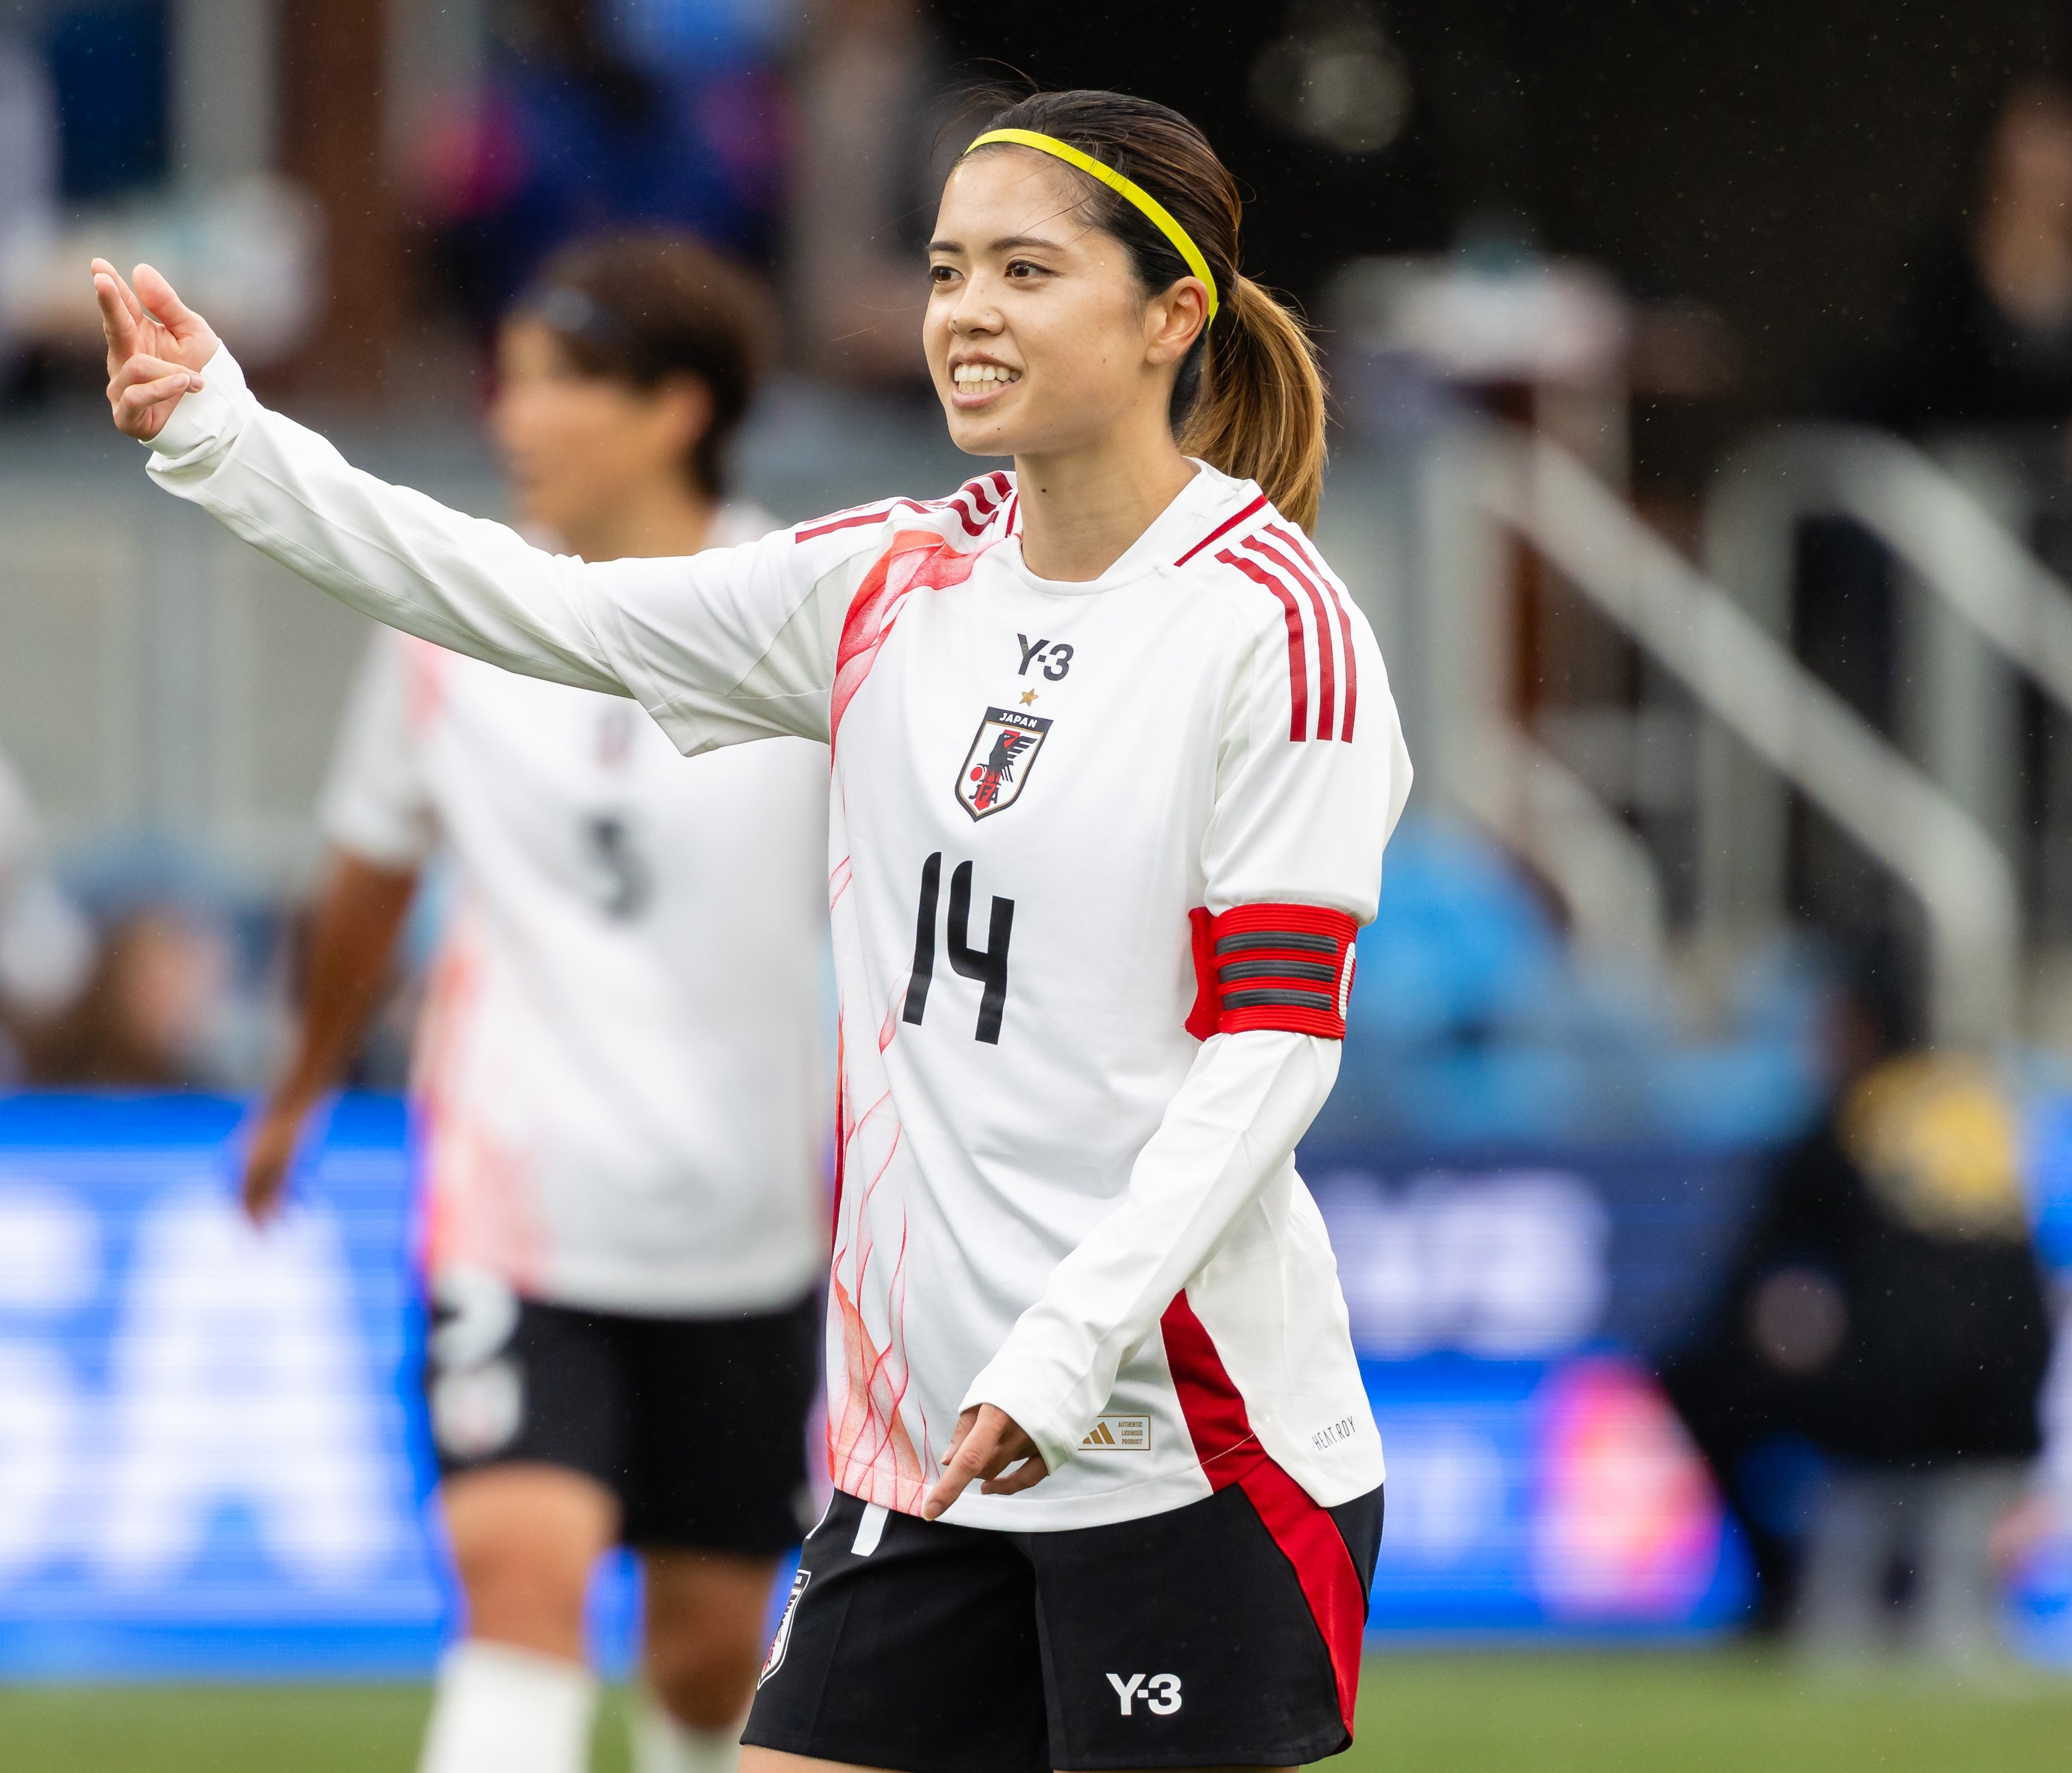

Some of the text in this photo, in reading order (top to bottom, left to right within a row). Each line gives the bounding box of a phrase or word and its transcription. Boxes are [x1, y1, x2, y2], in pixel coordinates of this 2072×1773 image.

[1017, 633, 1074, 681] Y-3
[999, 712, 1038, 729] JAPAN
[968, 784, 999, 804] JFA
[902, 851, 1015, 1045] 14
[1106, 1673, 1182, 1716] Y-3
